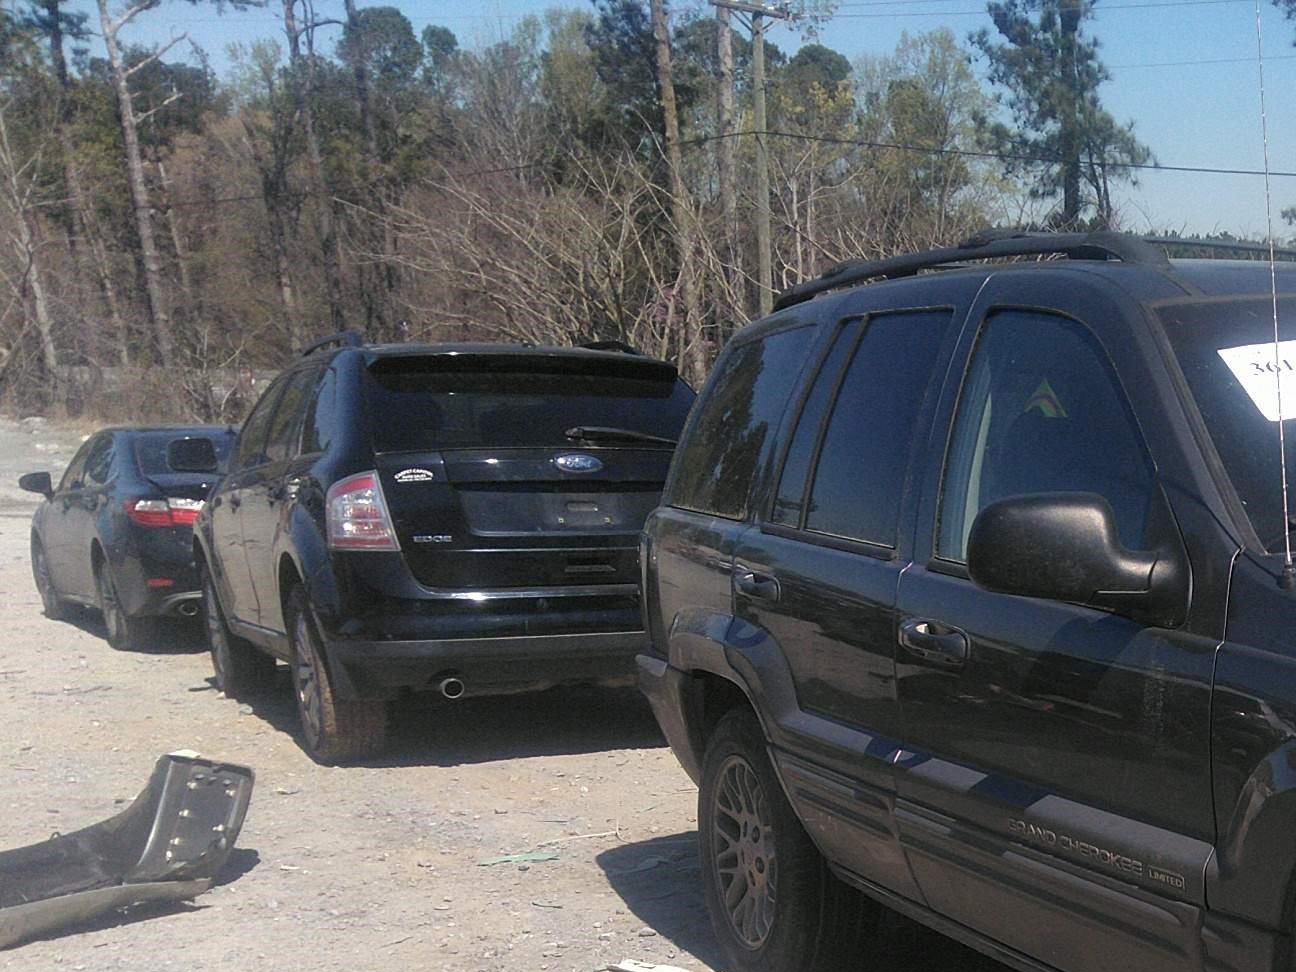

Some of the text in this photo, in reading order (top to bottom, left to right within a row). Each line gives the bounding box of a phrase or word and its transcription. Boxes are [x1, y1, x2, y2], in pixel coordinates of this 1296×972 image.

[413, 535, 452, 543] EDGE
[1007, 818, 1184, 889] GRAND CHEROKEE LIMITED
